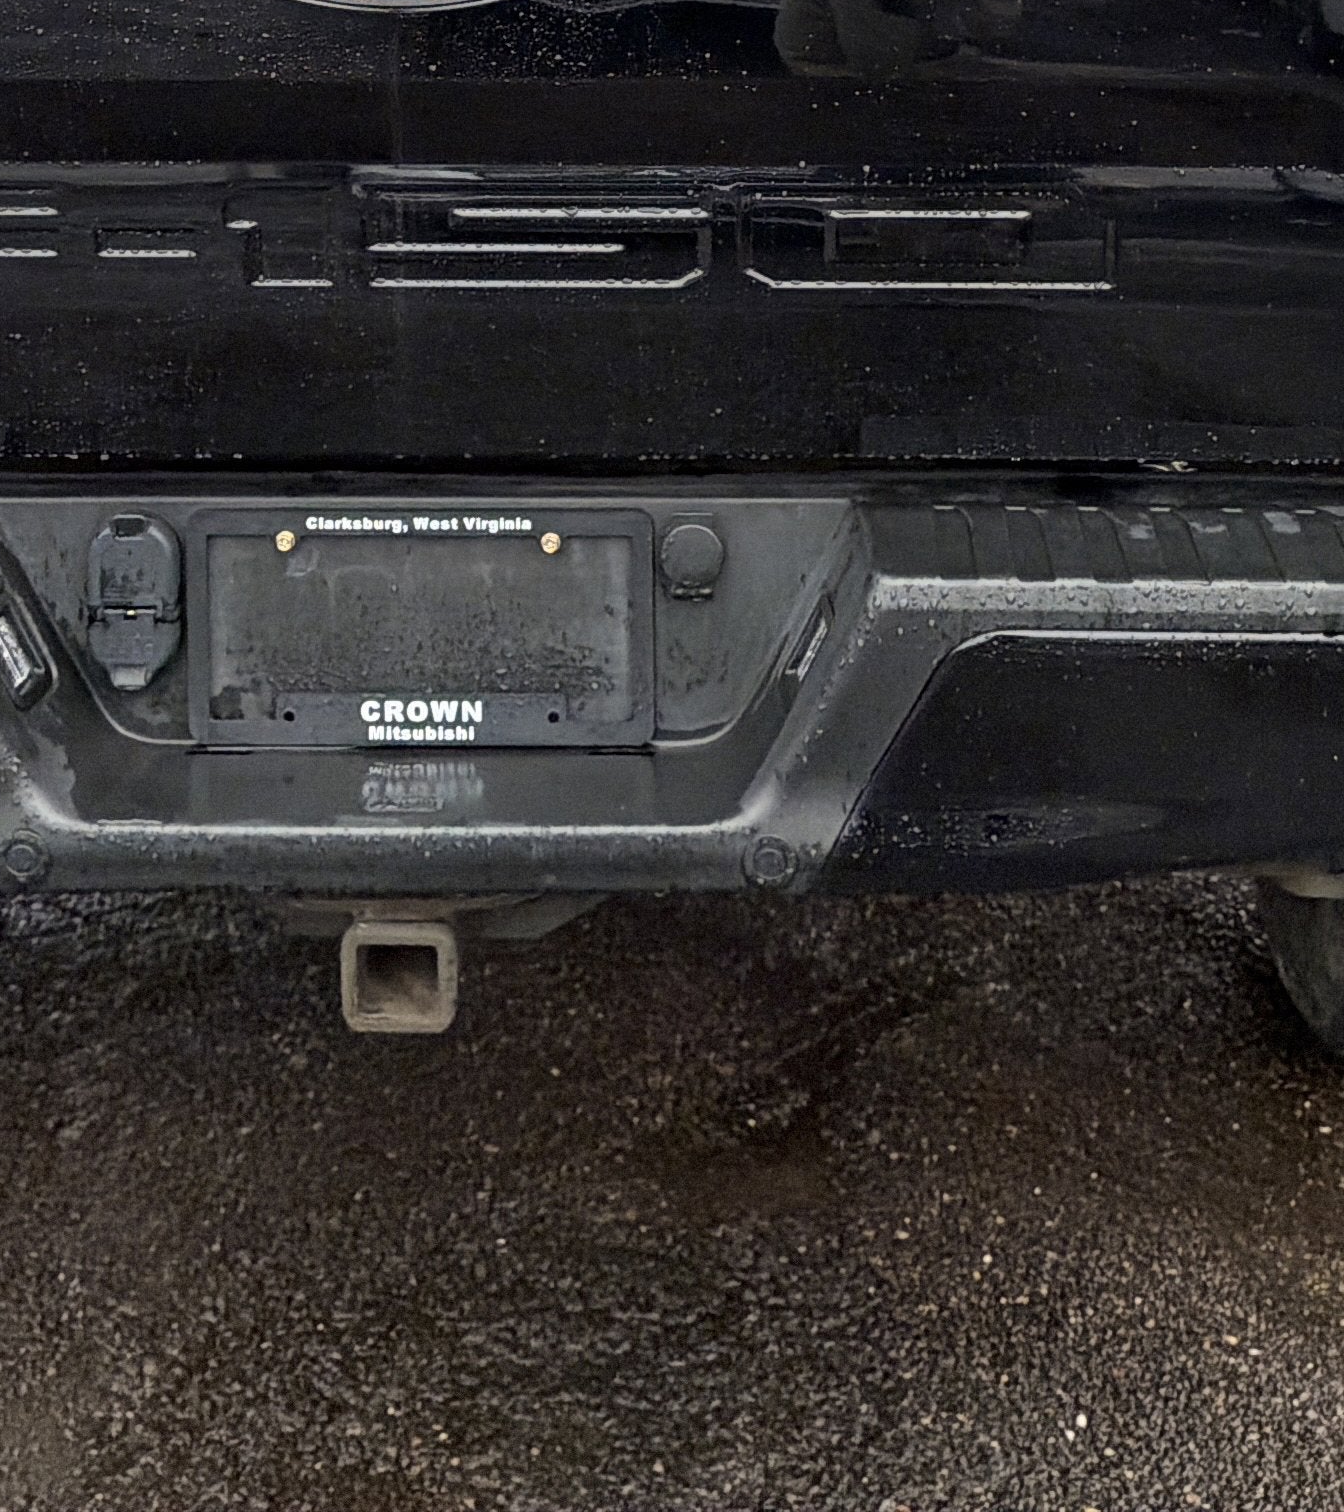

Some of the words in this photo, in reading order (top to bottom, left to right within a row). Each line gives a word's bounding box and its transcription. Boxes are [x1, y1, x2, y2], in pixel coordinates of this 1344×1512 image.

[305, 516, 409, 533] Clarksburg,
[412, 516, 459, 530] West
[462, 516, 532, 533] Virginia
[360, 700, 483, 723] CROWN
[368, 725, 475, 741] Mitsubishi
